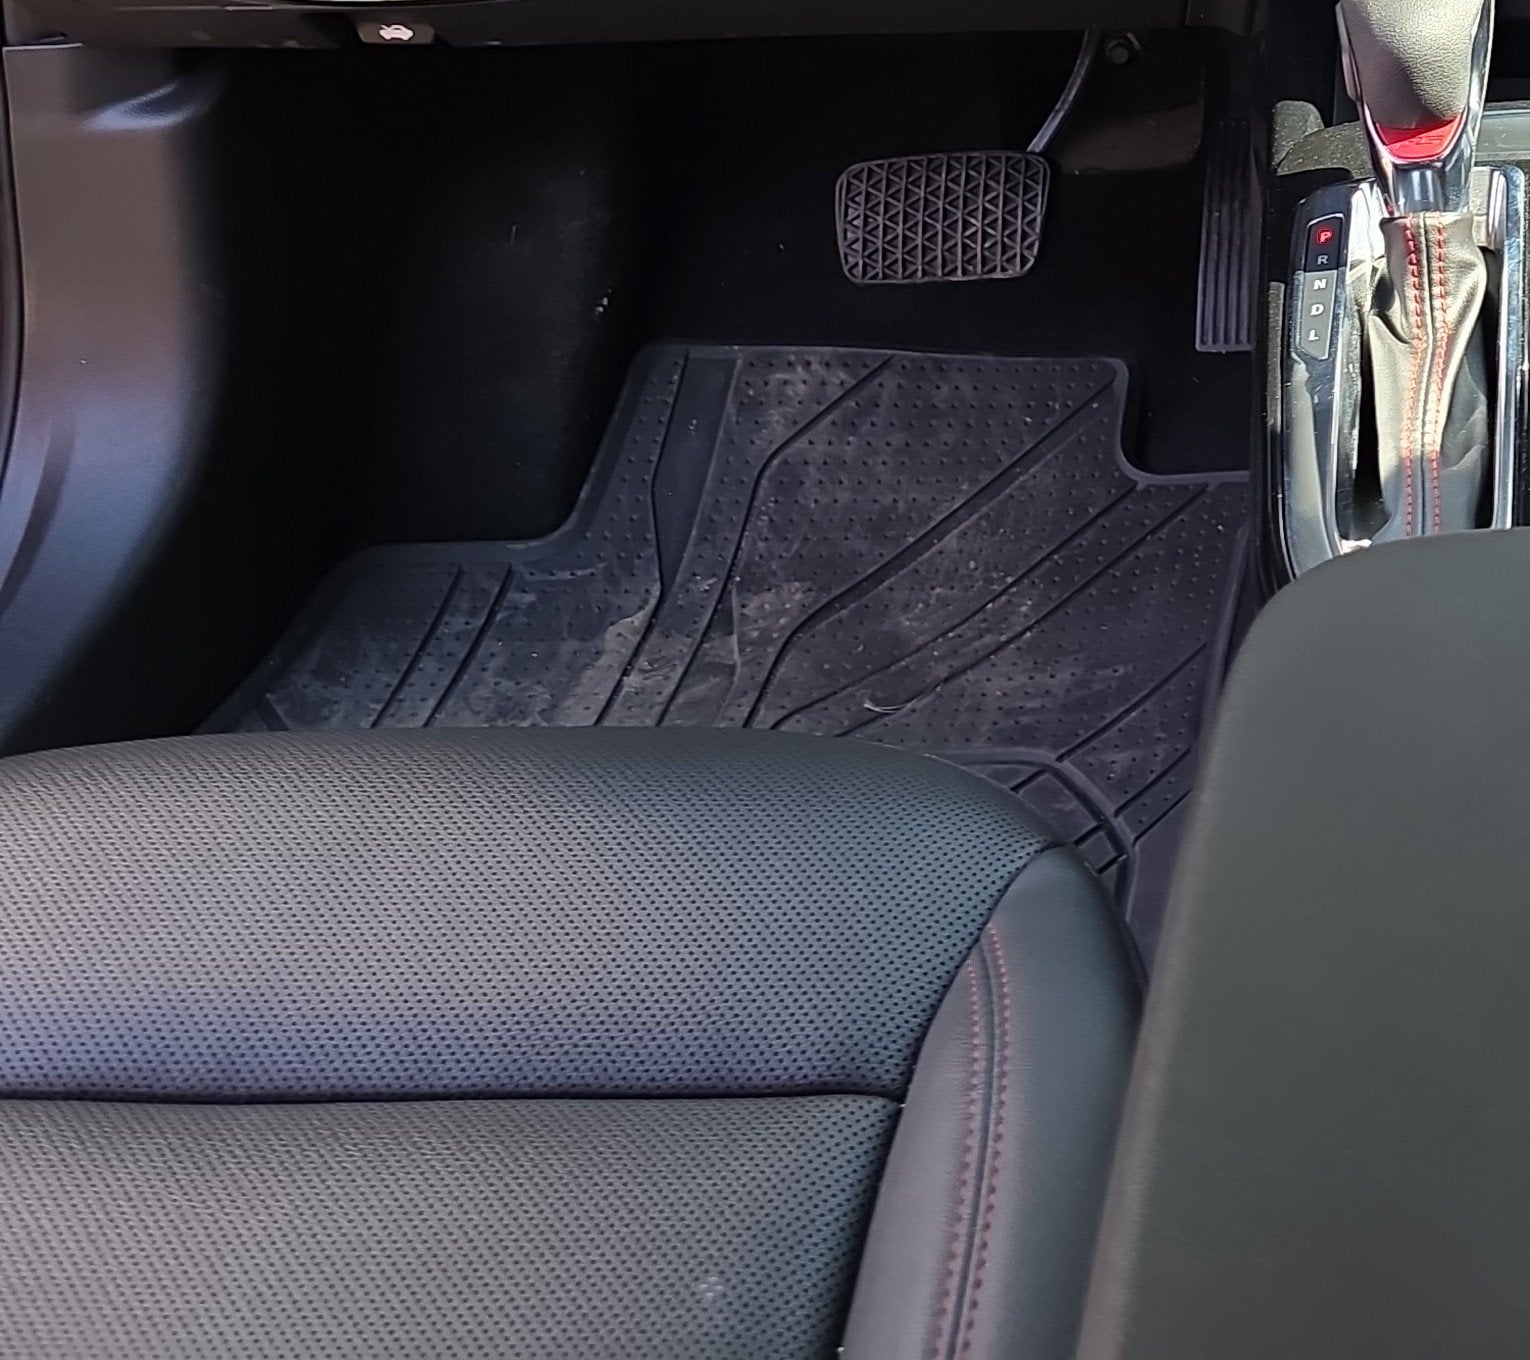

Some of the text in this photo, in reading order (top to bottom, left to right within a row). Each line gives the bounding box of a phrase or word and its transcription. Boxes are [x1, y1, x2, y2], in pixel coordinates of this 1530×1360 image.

[1318, 229, 1334, 244] P
[1317, 254, 1329, 266] R
[1313, 278, 1328, 291] N
[1310, 302, 1325, 317] D
[1308, 329, 1320, 341] L
